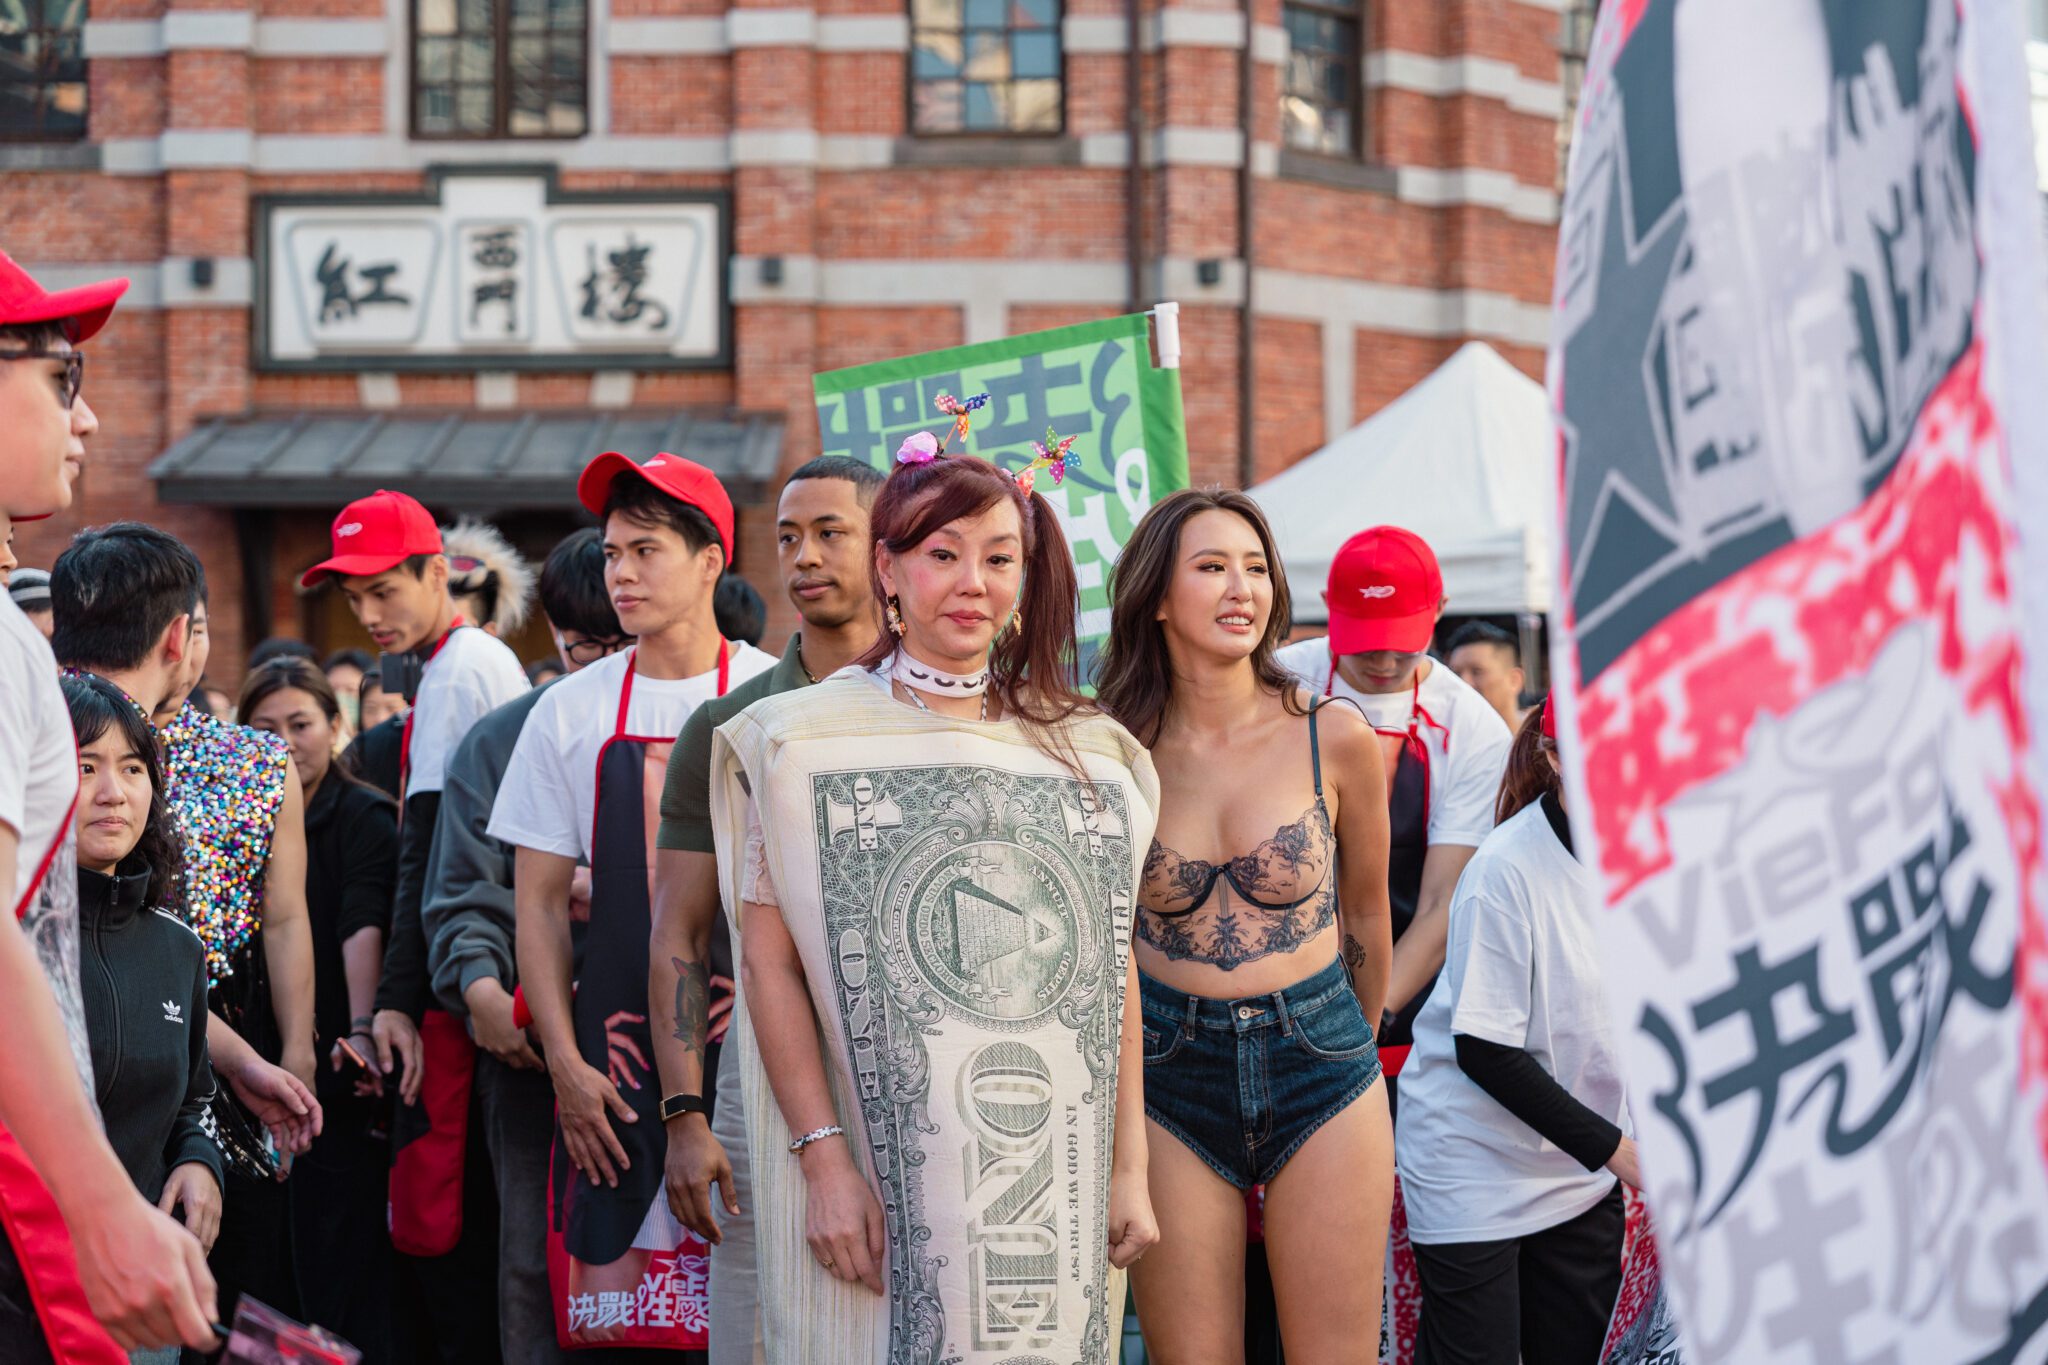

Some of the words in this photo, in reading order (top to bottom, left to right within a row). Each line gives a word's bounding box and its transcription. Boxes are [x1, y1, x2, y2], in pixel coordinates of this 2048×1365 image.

[469, 228, 520, 334] 西門
[852, 777, 879, 853] ONE
[1078, 788, 1104, 857] ONE
[924, 869, 957, 901] NOVUS
[1027, 864, 1070, 920] ANNUIT
[918, 905, 932, 937] ORDO
[920, 939, 968, 993] SECLORUM
[837, 928, 880, 1102] ONE
[1065, 1104, 1078, 1126] IN
[1066, 1132, 1079, 1176] GOD
[955, 1041, 1059, 1352] ONE
[1067, 1179, 1080, 1209] WE
[1069, 1214, 1081, 1282] TRUST
[643, 1272, 709, 1295] VieF
